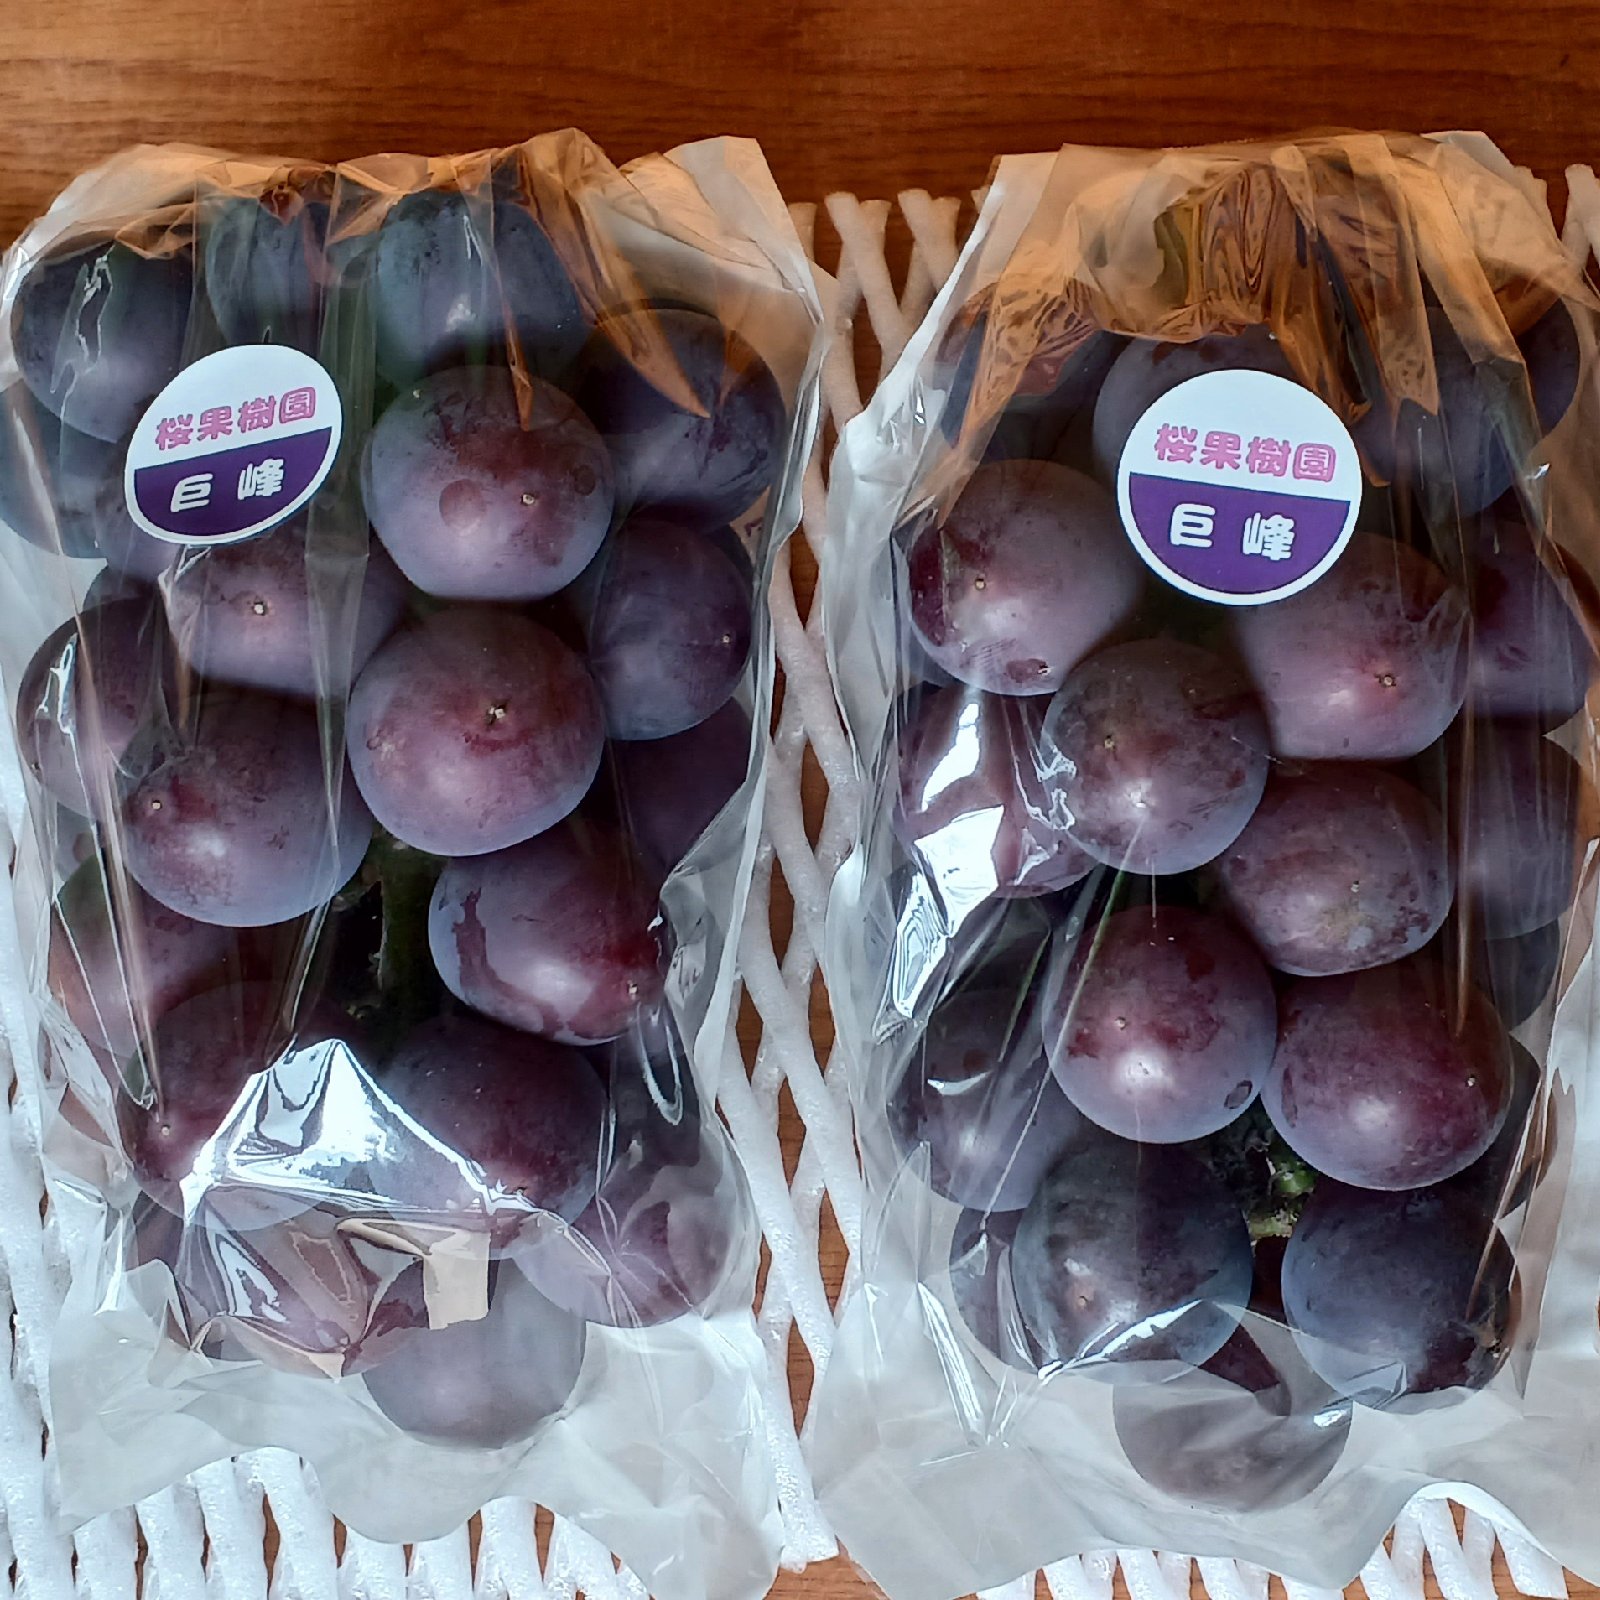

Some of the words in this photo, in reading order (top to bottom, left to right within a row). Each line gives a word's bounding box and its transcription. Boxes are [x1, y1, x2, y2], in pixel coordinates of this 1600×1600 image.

[155, 387, 316, 450] 桜果樹園
[1154, 423, 1336, 483] 桜果樹園
[170, 458, 284, 513] 巨峰
[1170, 503, 1295, 561] 巨峰
